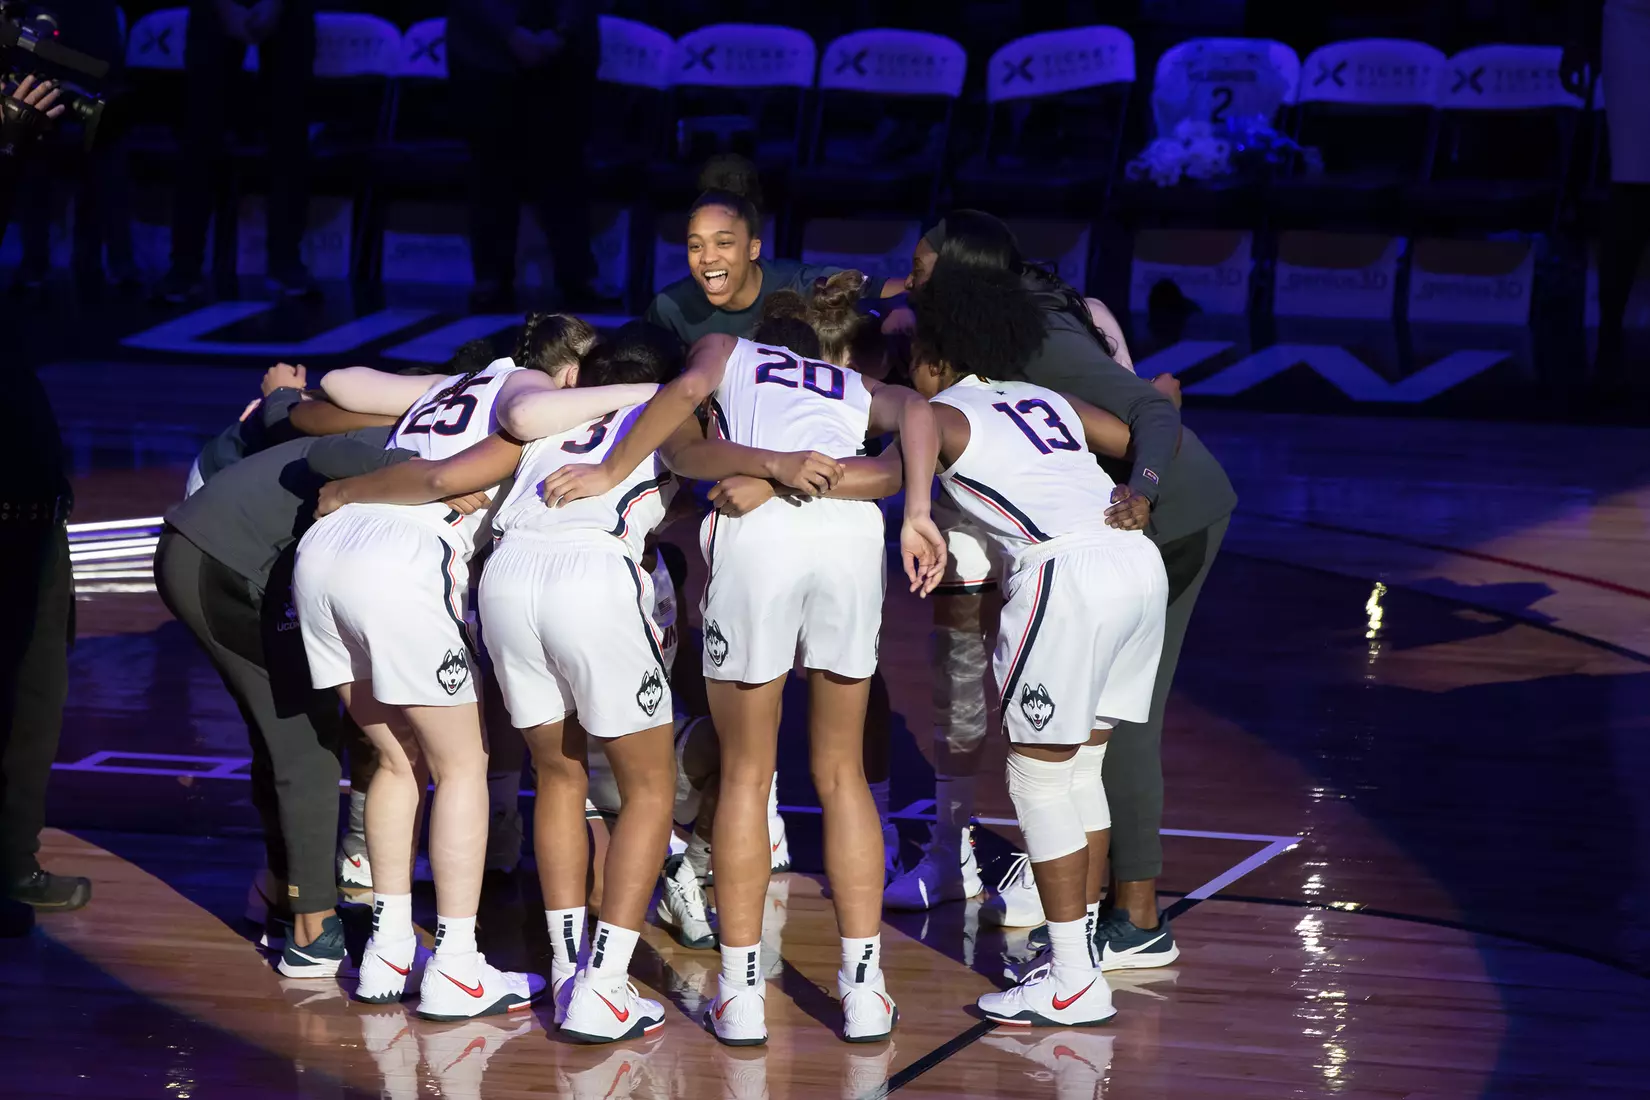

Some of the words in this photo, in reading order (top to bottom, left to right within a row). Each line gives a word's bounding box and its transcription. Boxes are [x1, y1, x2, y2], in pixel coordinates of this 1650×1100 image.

[1211, 87, 1231, 123] 2
[755, 348, 845, 401] 20
[400, 376, 495, 436] 25
[560, 408, 619, 454] 3
[992, 399, 1082, 455] 13
